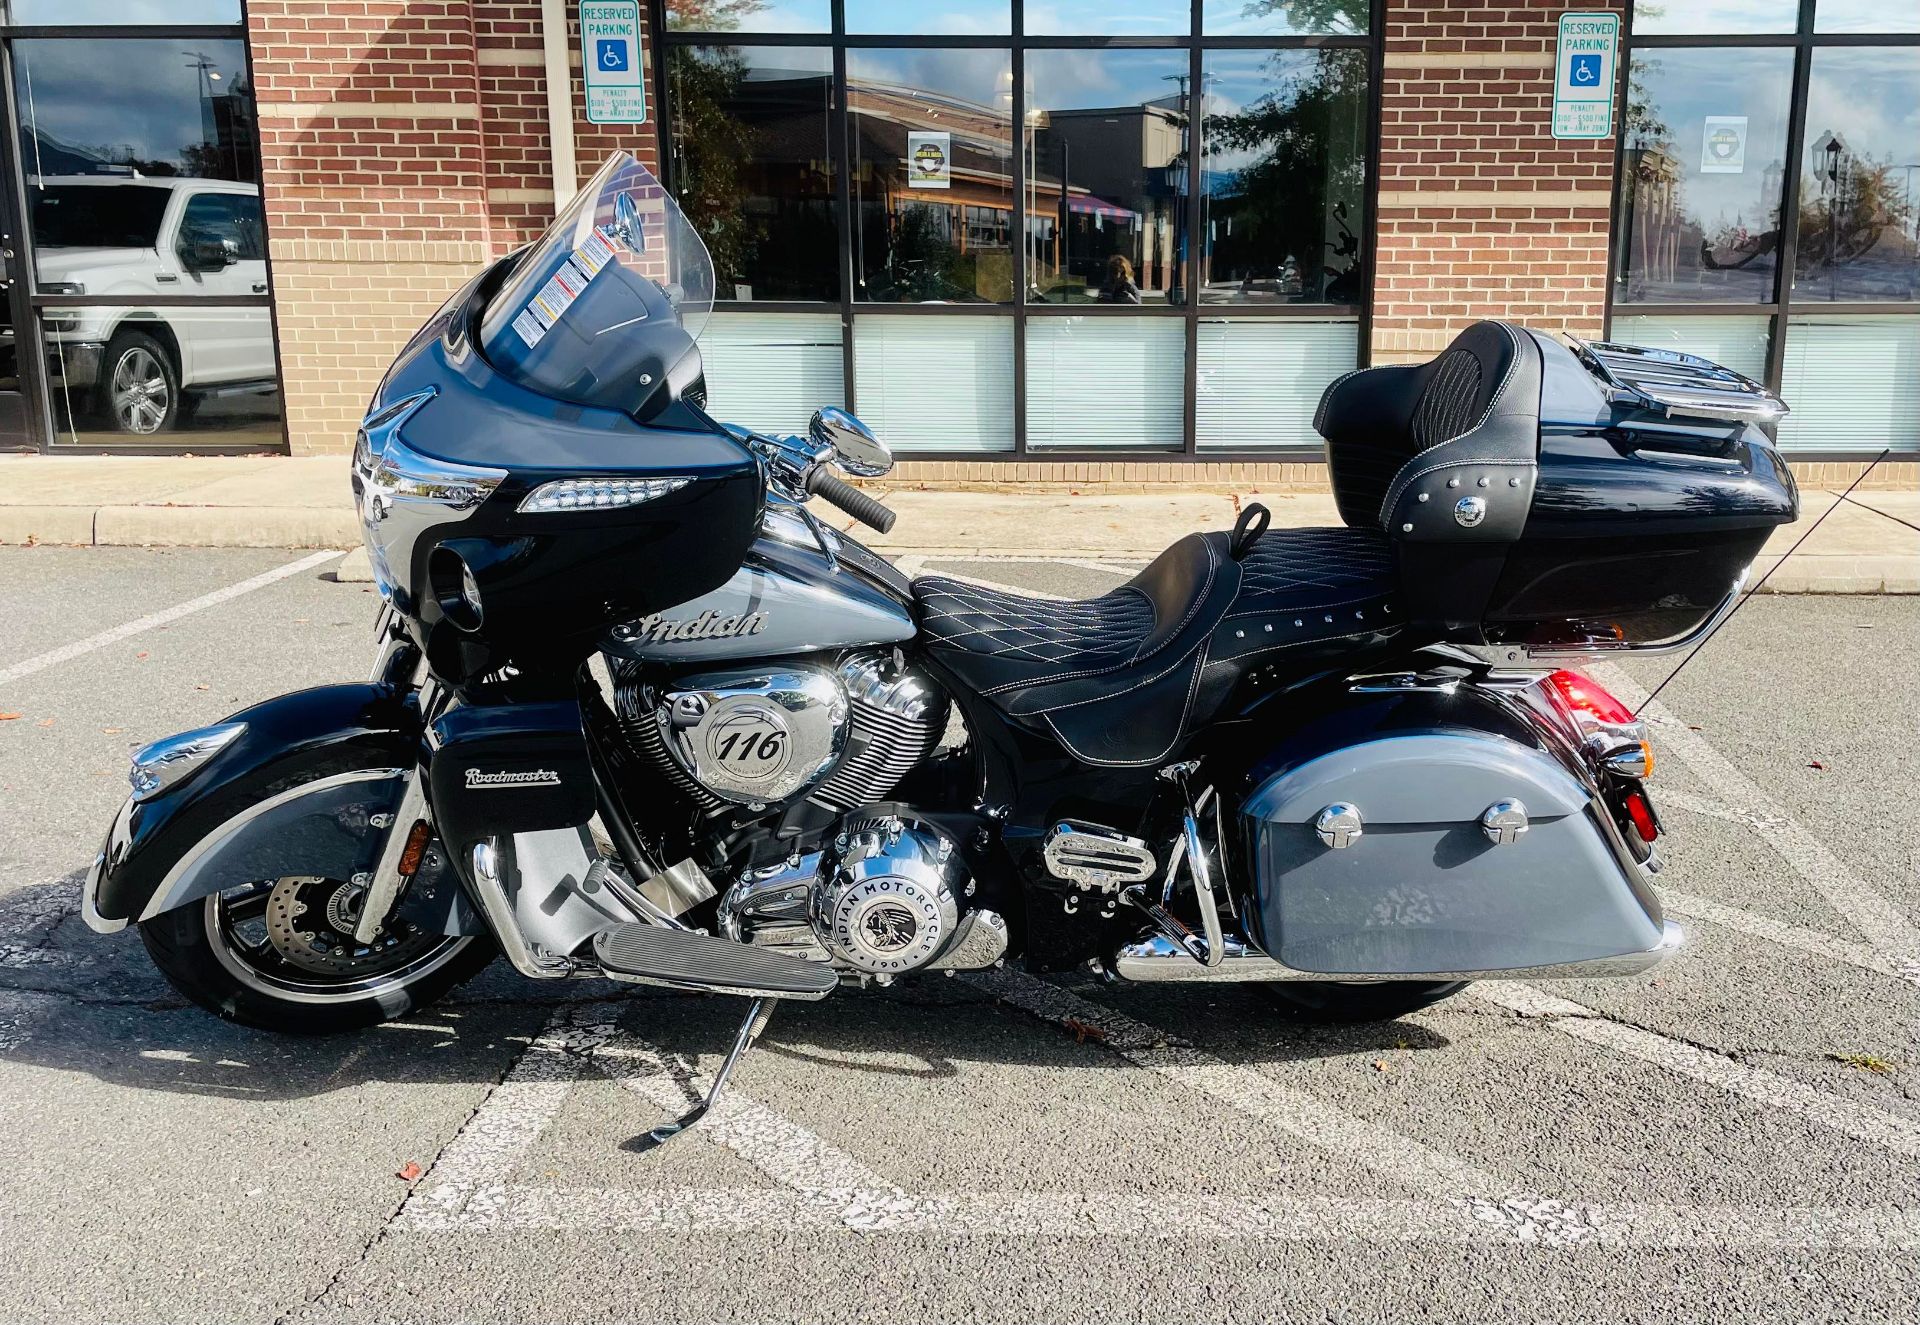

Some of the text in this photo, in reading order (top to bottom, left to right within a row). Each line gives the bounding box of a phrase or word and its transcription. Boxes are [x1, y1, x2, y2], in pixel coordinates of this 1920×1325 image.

[584, 8, 635, 20] RESERVED
[588, 23, 633, 36] PARKING
[1563, 22, 1615, 35] RESERVED
[1565, 38, 1610, 51] PARKING
[602, 89, 627, 97] PENALTY
[1570, 104, 1595, 112] PENALTY
[612, 609, 770, 643] Indian
[717, 730, 787, 761] 116
[464, 767, 561, 788] Roadmaster
[838, 881, 938, 953] INDIAN MOTORCYCLE
[871, 959, 908, 969] 1901
